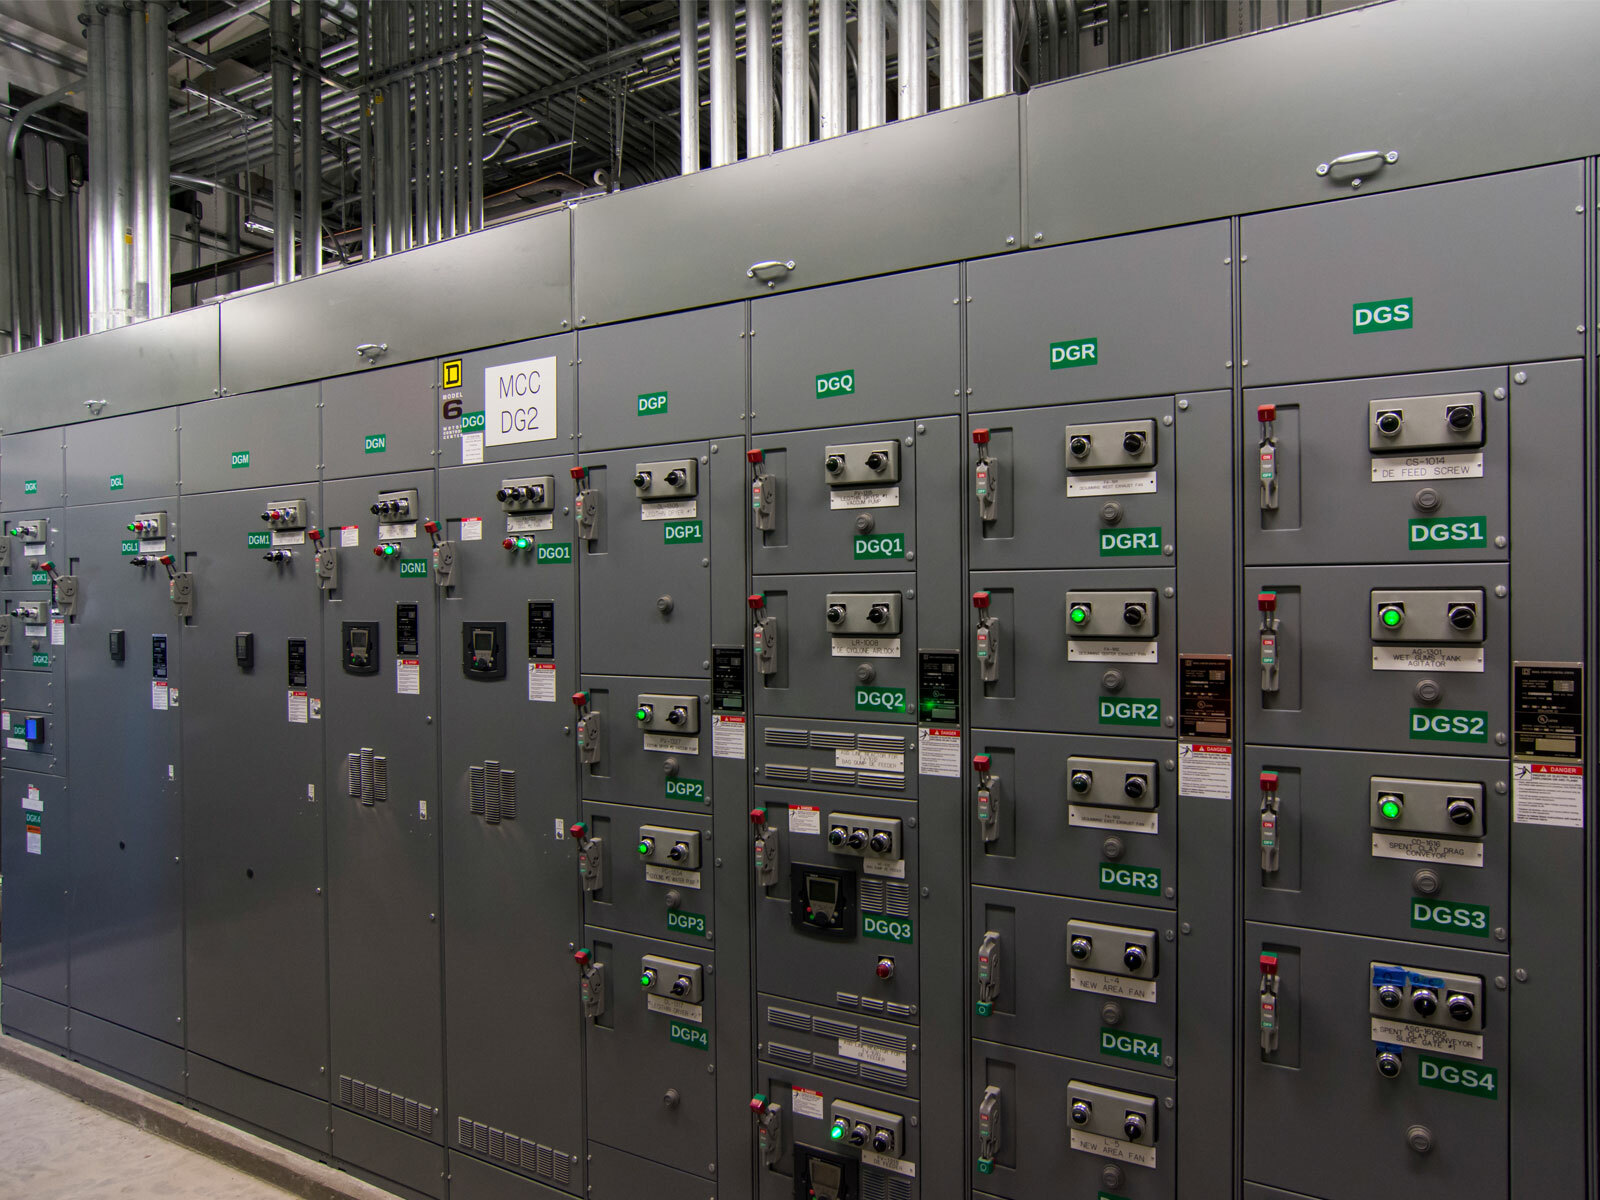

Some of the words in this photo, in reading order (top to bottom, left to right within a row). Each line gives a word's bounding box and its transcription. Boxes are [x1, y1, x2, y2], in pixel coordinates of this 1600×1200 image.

[1355, 304, 1410, 327] DGS
[1052, 343, 1095, 363] DGR
[499, 370, 541, 399] MCC
[817, 374, 853, 393] DGQ
[442, 391, 463, 400] MODEL
[639, 396, 667, 411] DGP
[443, 399, 463, 419] 6
[462, 415, 485, 428] DGO
[501, 406, 539, 434] DG2
[366, 437, 385, 450] DGN
[232, 453, 249, 465] DGM
[1405, 457, 1445, 466] CS-1014
[1382, 469, 1395, 478] DE
[1401, 467, 1427, 477] FEED
[1433, 465, 1470, 476] SCREW
[110, 477, 123, 487] DGL
[249, 535, 270, 545] DGM1
[665, 525, 701, 539] DGP1
[1102, 532, 1159, 550] DGR1
[1411, 522, 1484, 542] DGS1
[122, 542, 138, 552] DGL1
[538, 547, 570, 559] DGO1
[856, 538, 903, 556] DGQ1
[401, 562, 426, 574] DGN1
[857, 691, 904, 709] DGQ2
[1101, 702, 1158, 720] DGR2
[1412, 714, 1485, 735] DGS2
[666, 781, 703, 797] DGP2
[1389, 842, 1412, 850] SPENT
[1443, 847, 1465, 856] DRAG
[1406, 849, 1447, 859] CONVEYOR
[1101, 867, 1159, 889] DGR3
[668, 912, 704, 931] DGP3
[1414, 903, 1486, 929] DGS3
[864, 917, 911, 940] DGQ3
[1079, 980, 1097, 990] NEW
[1102, 984, 1123, 994] AREA
[1128, 988, 1146, 998] FAN
[671, 1024, 708, 1046] DGP4
[1102, 1032, 1160, 1058] DGR4
[1421, 1061, 1495, 1091] DGS4
[1079, 1141, 1097, 1151] NEW
[1102, 1146, 1123, 1157] AREA
[1128, 1152, 1146, 1163] FAN
